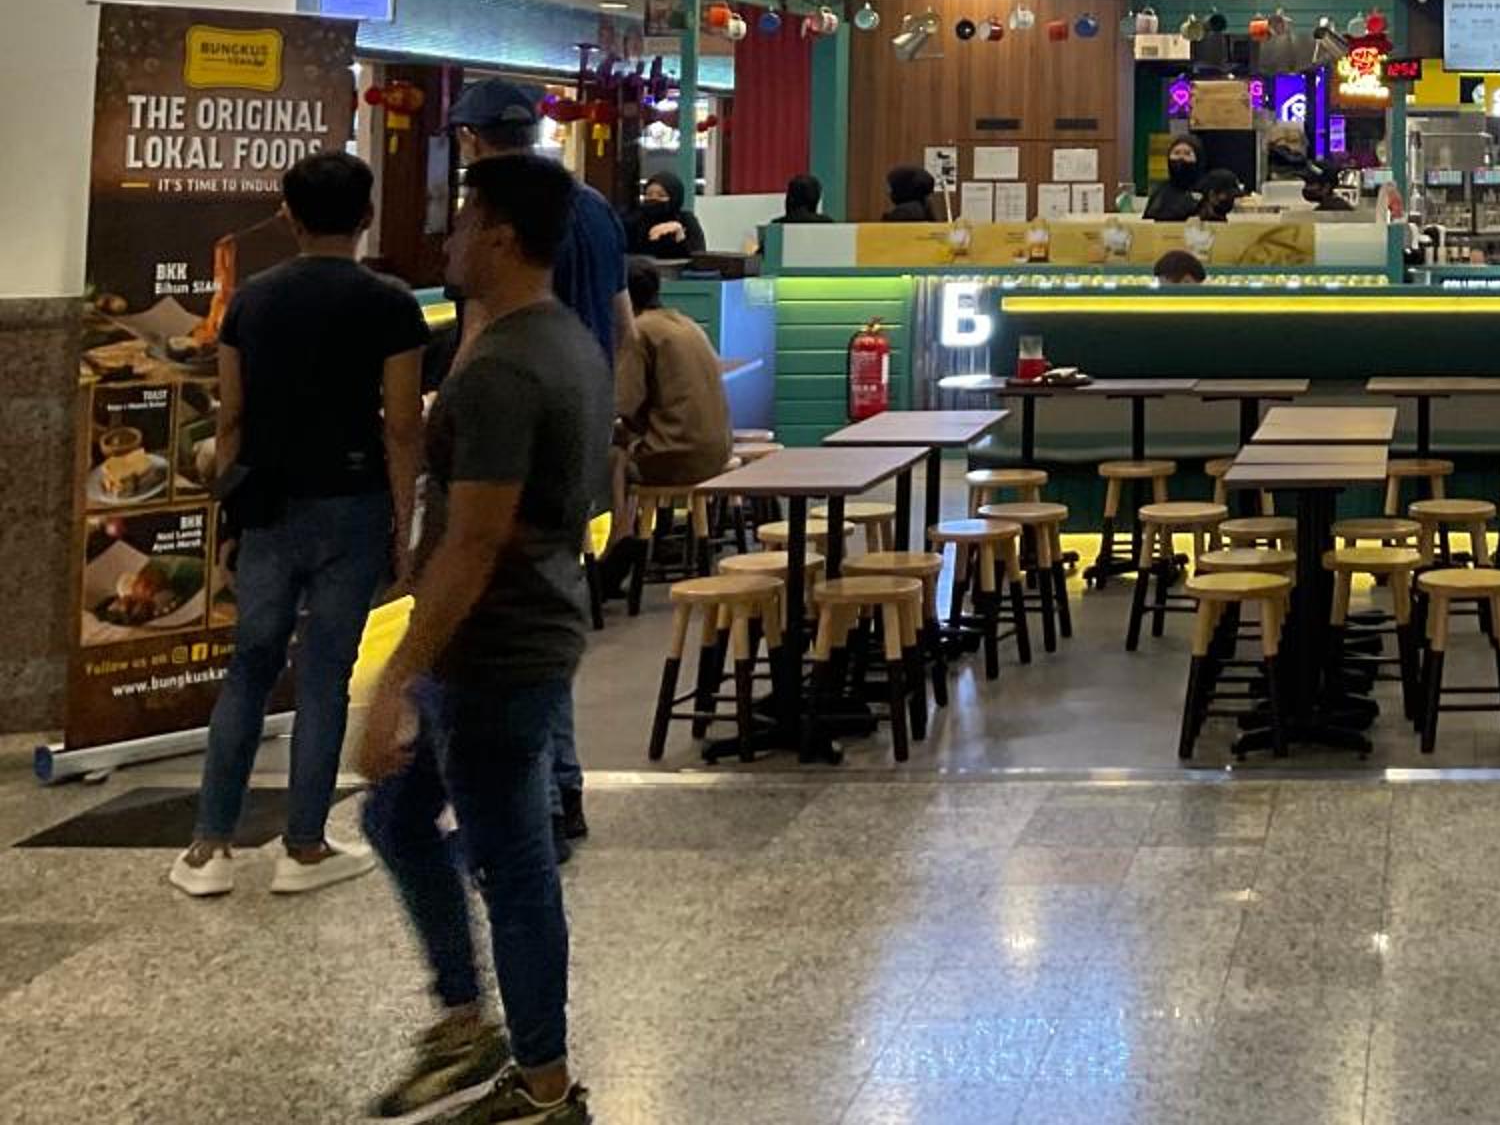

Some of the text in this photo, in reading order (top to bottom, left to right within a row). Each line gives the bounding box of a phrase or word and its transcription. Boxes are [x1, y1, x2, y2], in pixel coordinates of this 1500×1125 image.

[128, 94, 329, 133] THE ORIGINAL
[126, 134, 224, 170] LOKAL
[158, 178, 281, 192] IT'S TIME TO INDUL
[156, 262, 188, 281] BKK
[155, 281, 190, 295] Bihun
[940, 281, 995, 348] B
